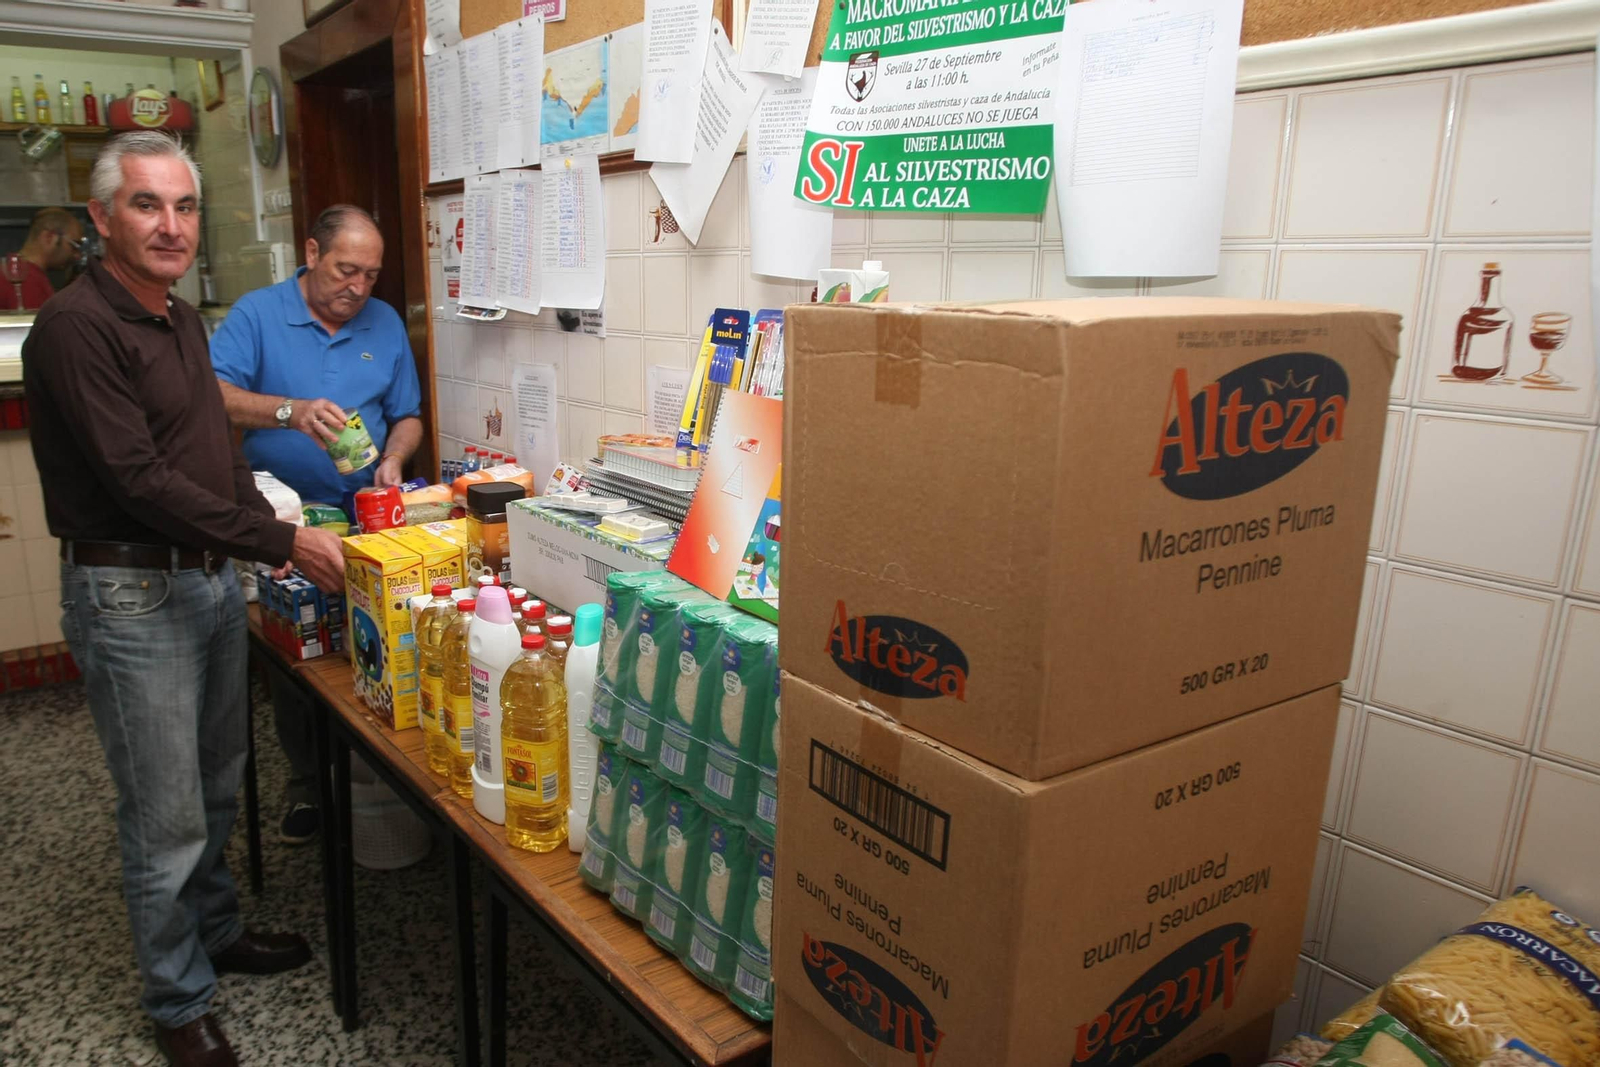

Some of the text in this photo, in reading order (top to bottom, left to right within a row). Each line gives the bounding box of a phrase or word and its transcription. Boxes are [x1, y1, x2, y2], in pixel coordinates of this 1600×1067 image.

[829, 33, 840, 50] A
[843, 27, 881, 50] FAVOR
[882, 22, 904, 45] DEL
[907, 7, 996, 41] SILVESTRISMO
[999, 5, 1011, 26] Y
[1011, 1, 1028, 23] LA
[884, 59, 912, 76] Sevilla
[914, 57, 927, 72] 27
[929, 55, 940, 69] de
[941, 49, 1001, 72] Septiembre
[906, 70, 969, 90] a las 11:00 h.
[1022, 52, 1059, 77] en tu Peña
[830, 88, 1051, 115] Todas las Asociaciones silvestristas y caza de Andalucía
[836, 106, 1039, 132] CON 150.000 ANDALUCES NO SE JUEGA
[903, 133, 1005, 152] UNETE A LA LUCHA
[802, 140, 863, 206] SI
[863, 156, 1050, 182] AL SILVESTRISMO
[859, 186, 971, 208] A LA CAZA
[1149, 367, 1346, 477] Alteza
[1139, 504, 1335, 562] Macarrones Pluma
[387, 576, 407, 588] BOLAS
[391, 584, 420, 596] CHOCOLATE
[428, 567, 447, 579] BOLAS
[1197, 554, 1282, 593] Pennine
[823, 600, 967, 703] Alteza
[1180, 653, 1269, 695] 500 GR X 20
[1154, 761, 1242, 810] 500 GR X 20
[833, 816, 910, 875] 500 GR X 20
[1147, 852, 1229, 904] Pennine
[834, 872, 902, 936] Pennine
[1083, 865, 1272, 969] Macarrones Pluma
[796, 871, 949, 999] Macarrones Pluma
[803, 930, 946, 1067] Alteza
[1074, 927, 1259, 1063] Alteza
